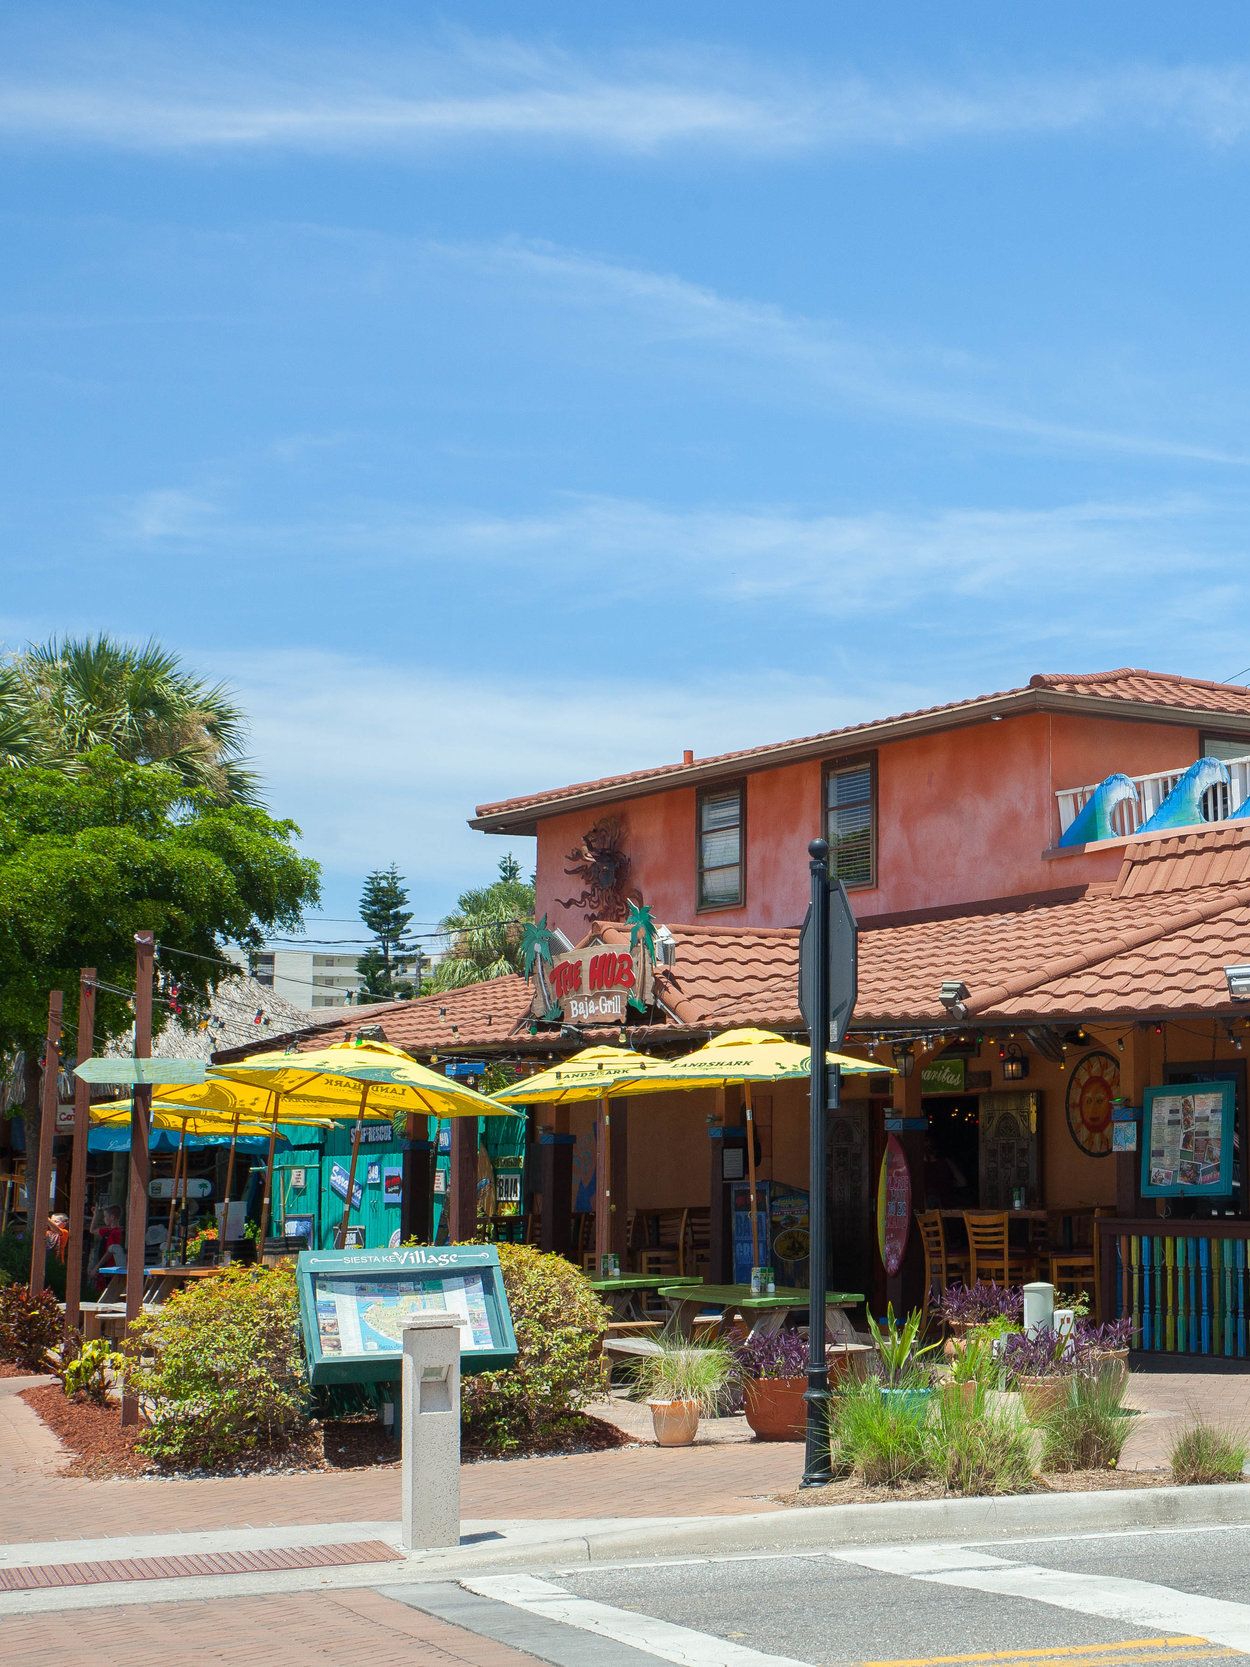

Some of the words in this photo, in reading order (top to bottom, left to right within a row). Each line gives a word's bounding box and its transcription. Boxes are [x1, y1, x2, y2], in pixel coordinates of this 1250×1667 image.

[549, 960, 582, 998] THE
[589, 952, 635, 991] HUB
[570, 995, 622, 1019] Baja-Grill
[671, 1060, 754, 1069] LANDSHARK
[558, 1068, 630, 1080] ANDSARK
[921, 1066, 962, 1086] aritas
[368, 1124, 393, 1142] RESCUE
[343, 1255, 380, 1264] SIESTA
[392, 1250, 459, 1266] Village
